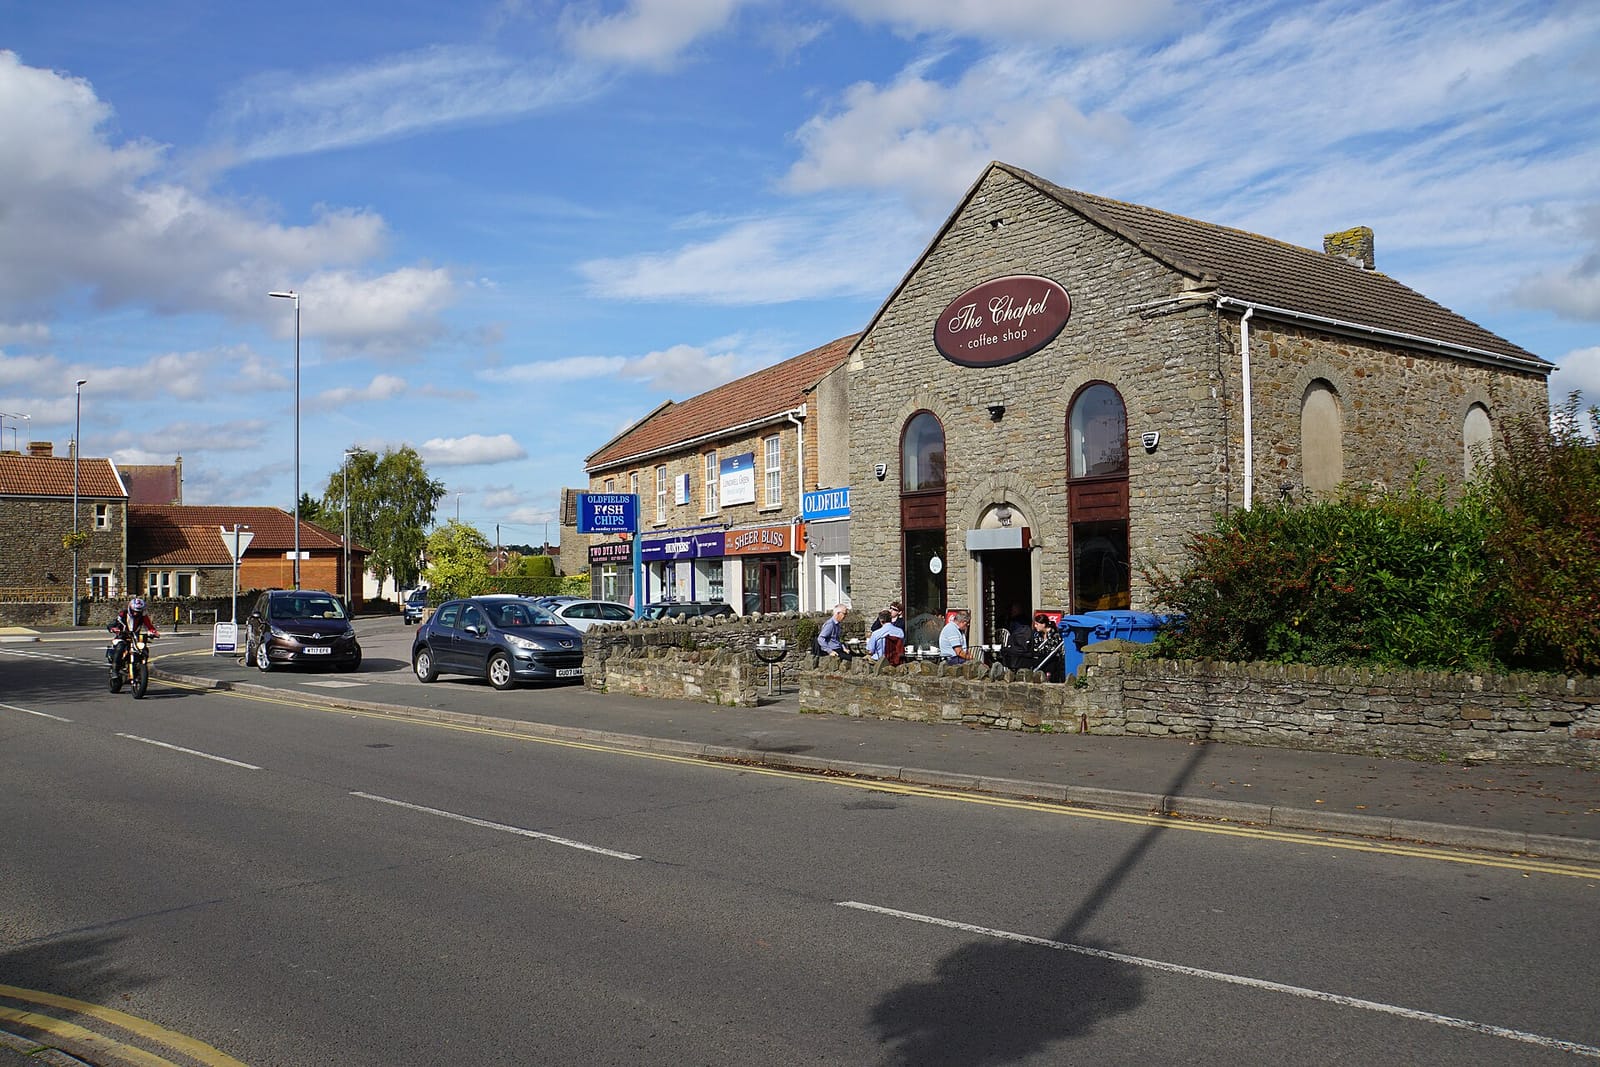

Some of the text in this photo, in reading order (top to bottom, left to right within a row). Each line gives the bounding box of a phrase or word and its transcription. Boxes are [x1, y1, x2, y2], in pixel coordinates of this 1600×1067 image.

[948, 288, 1052, 334] The Chapel
[967, 328, 1028, 350] coffee shop
[587, 495, 630, 504] OLDFIELDS
[594, 515, 625, 526] CHIPS
[734, 530, 759, 550] SHEER
[761, 530, 784, 547] BLISS
[590, 547, 602, 557] TWO
[602, 546, 613, 556] DYE
[614, 544, 631, 555] FOUR
